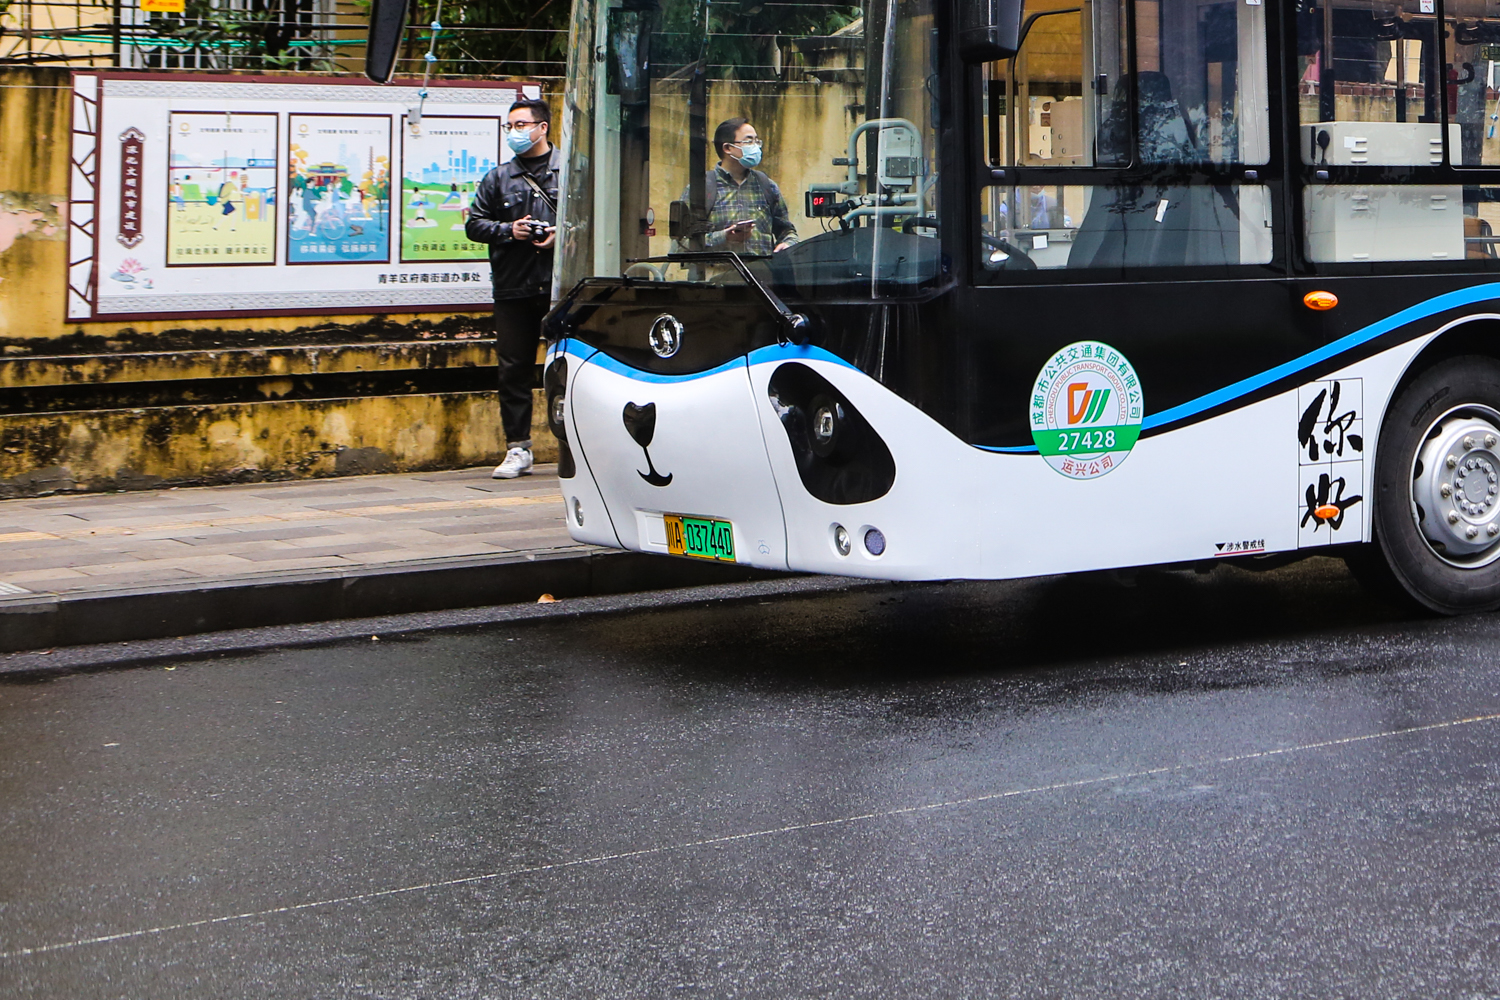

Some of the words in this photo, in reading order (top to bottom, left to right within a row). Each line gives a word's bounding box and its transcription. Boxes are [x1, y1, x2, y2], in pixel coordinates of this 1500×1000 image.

[378, 272, 481, 284] 青羊区府南街道办事处
[1032, 344, 1141, 425] 成都市公共交通集团有限公司
[1048, 387, 1058, 424] CHENGDU
[1055, 368, 1074, 389] PUBLIC
[1073, 362, 1108, 374] TRANSPORT
[1106, 371, 1123, 392] GROUP
[1058, 430, 1116, 451] 27428
[1061, 455, 1113, 476] 运兴公司
[1226, 539, 1265, 551] 涉水警戒线
